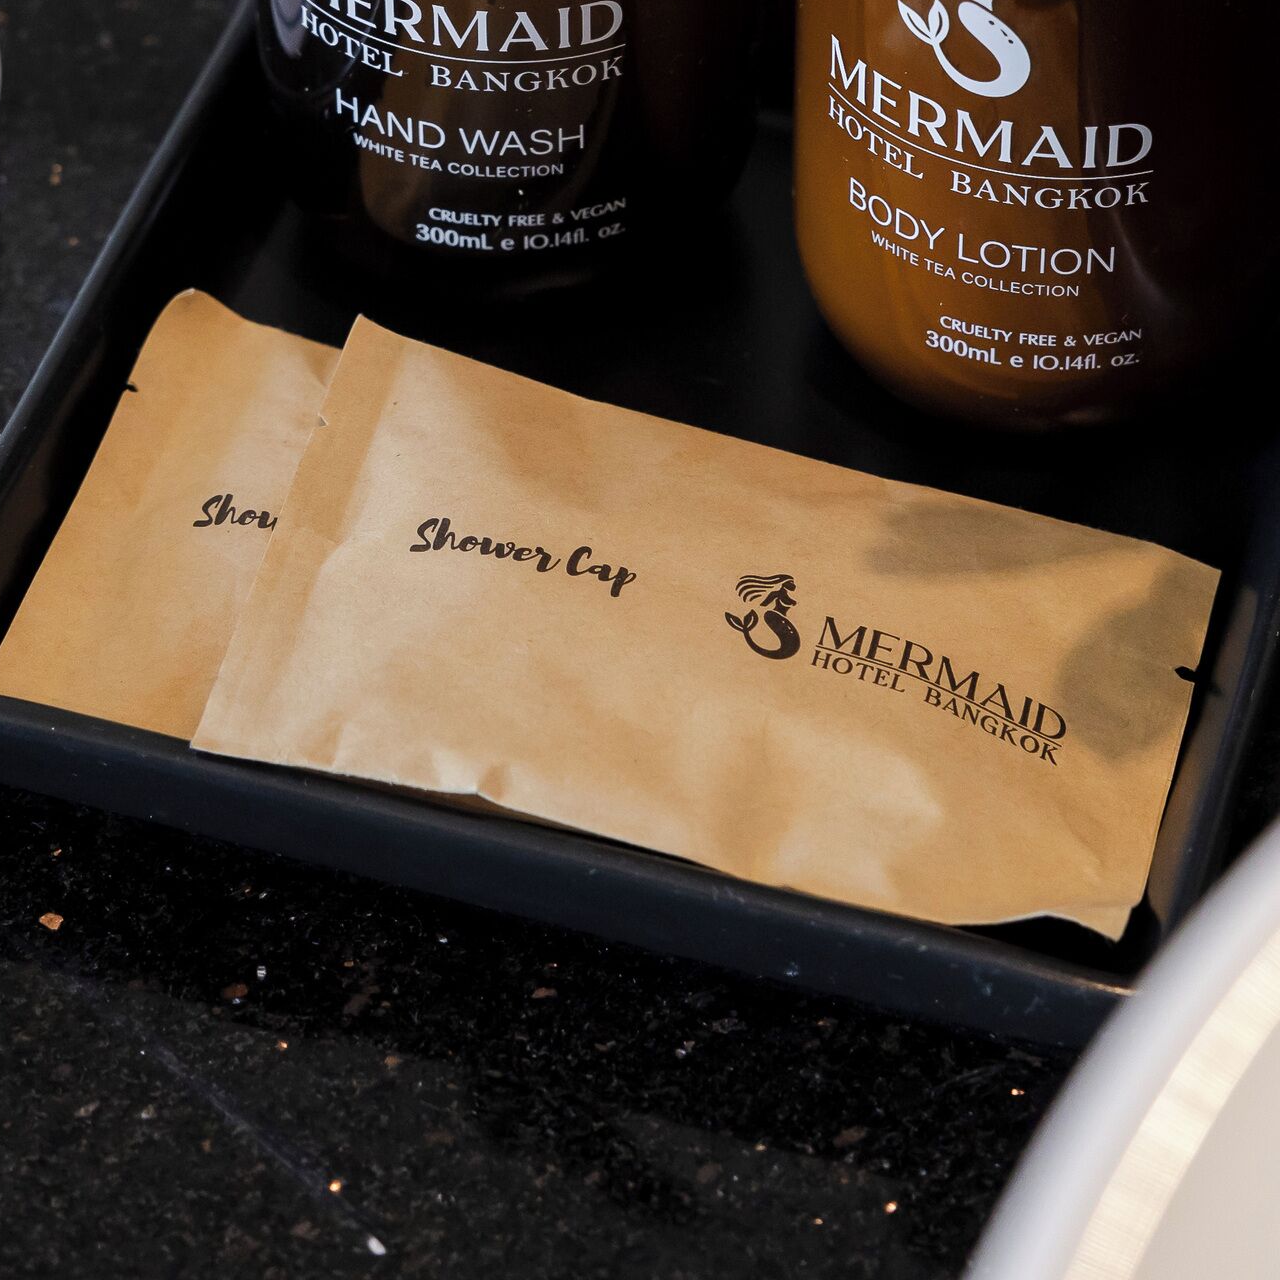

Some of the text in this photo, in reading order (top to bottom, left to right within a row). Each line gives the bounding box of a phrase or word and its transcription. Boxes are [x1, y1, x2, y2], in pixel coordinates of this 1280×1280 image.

[300, 4, 625, 93] HOTEL BANGKOK
[335, 87, 585, 157] HAND WASH
[830, 33, 1153, 170] MERMAID
[352, 131, 565, 179] WHITE TEA COLLECTION
[827, 94, 1150, 210] HOTEL BANGKOK
[415, 222, 495, 252] 300mL
[598, 222, 627, 239] oz.
[428, 196, 628, 228] CRUELTY FREE & VEGAN
[848, 176, 1116, 276] BODY LOTION
[871, 229, 1081, 298] WHITE TEA COLLECTION
[924, 329, 1003, 366] 300mL
[1110, 352, 1140, 368] oz.
[939, 315, 1143, 348] CRUELTY FREE & VEGAN
[409, 517, 638, 598] Shower Cap
[810, 648, 1059, 767] HOTEL BANGKOK
[816, 616, 1067, 740] MERMAID
